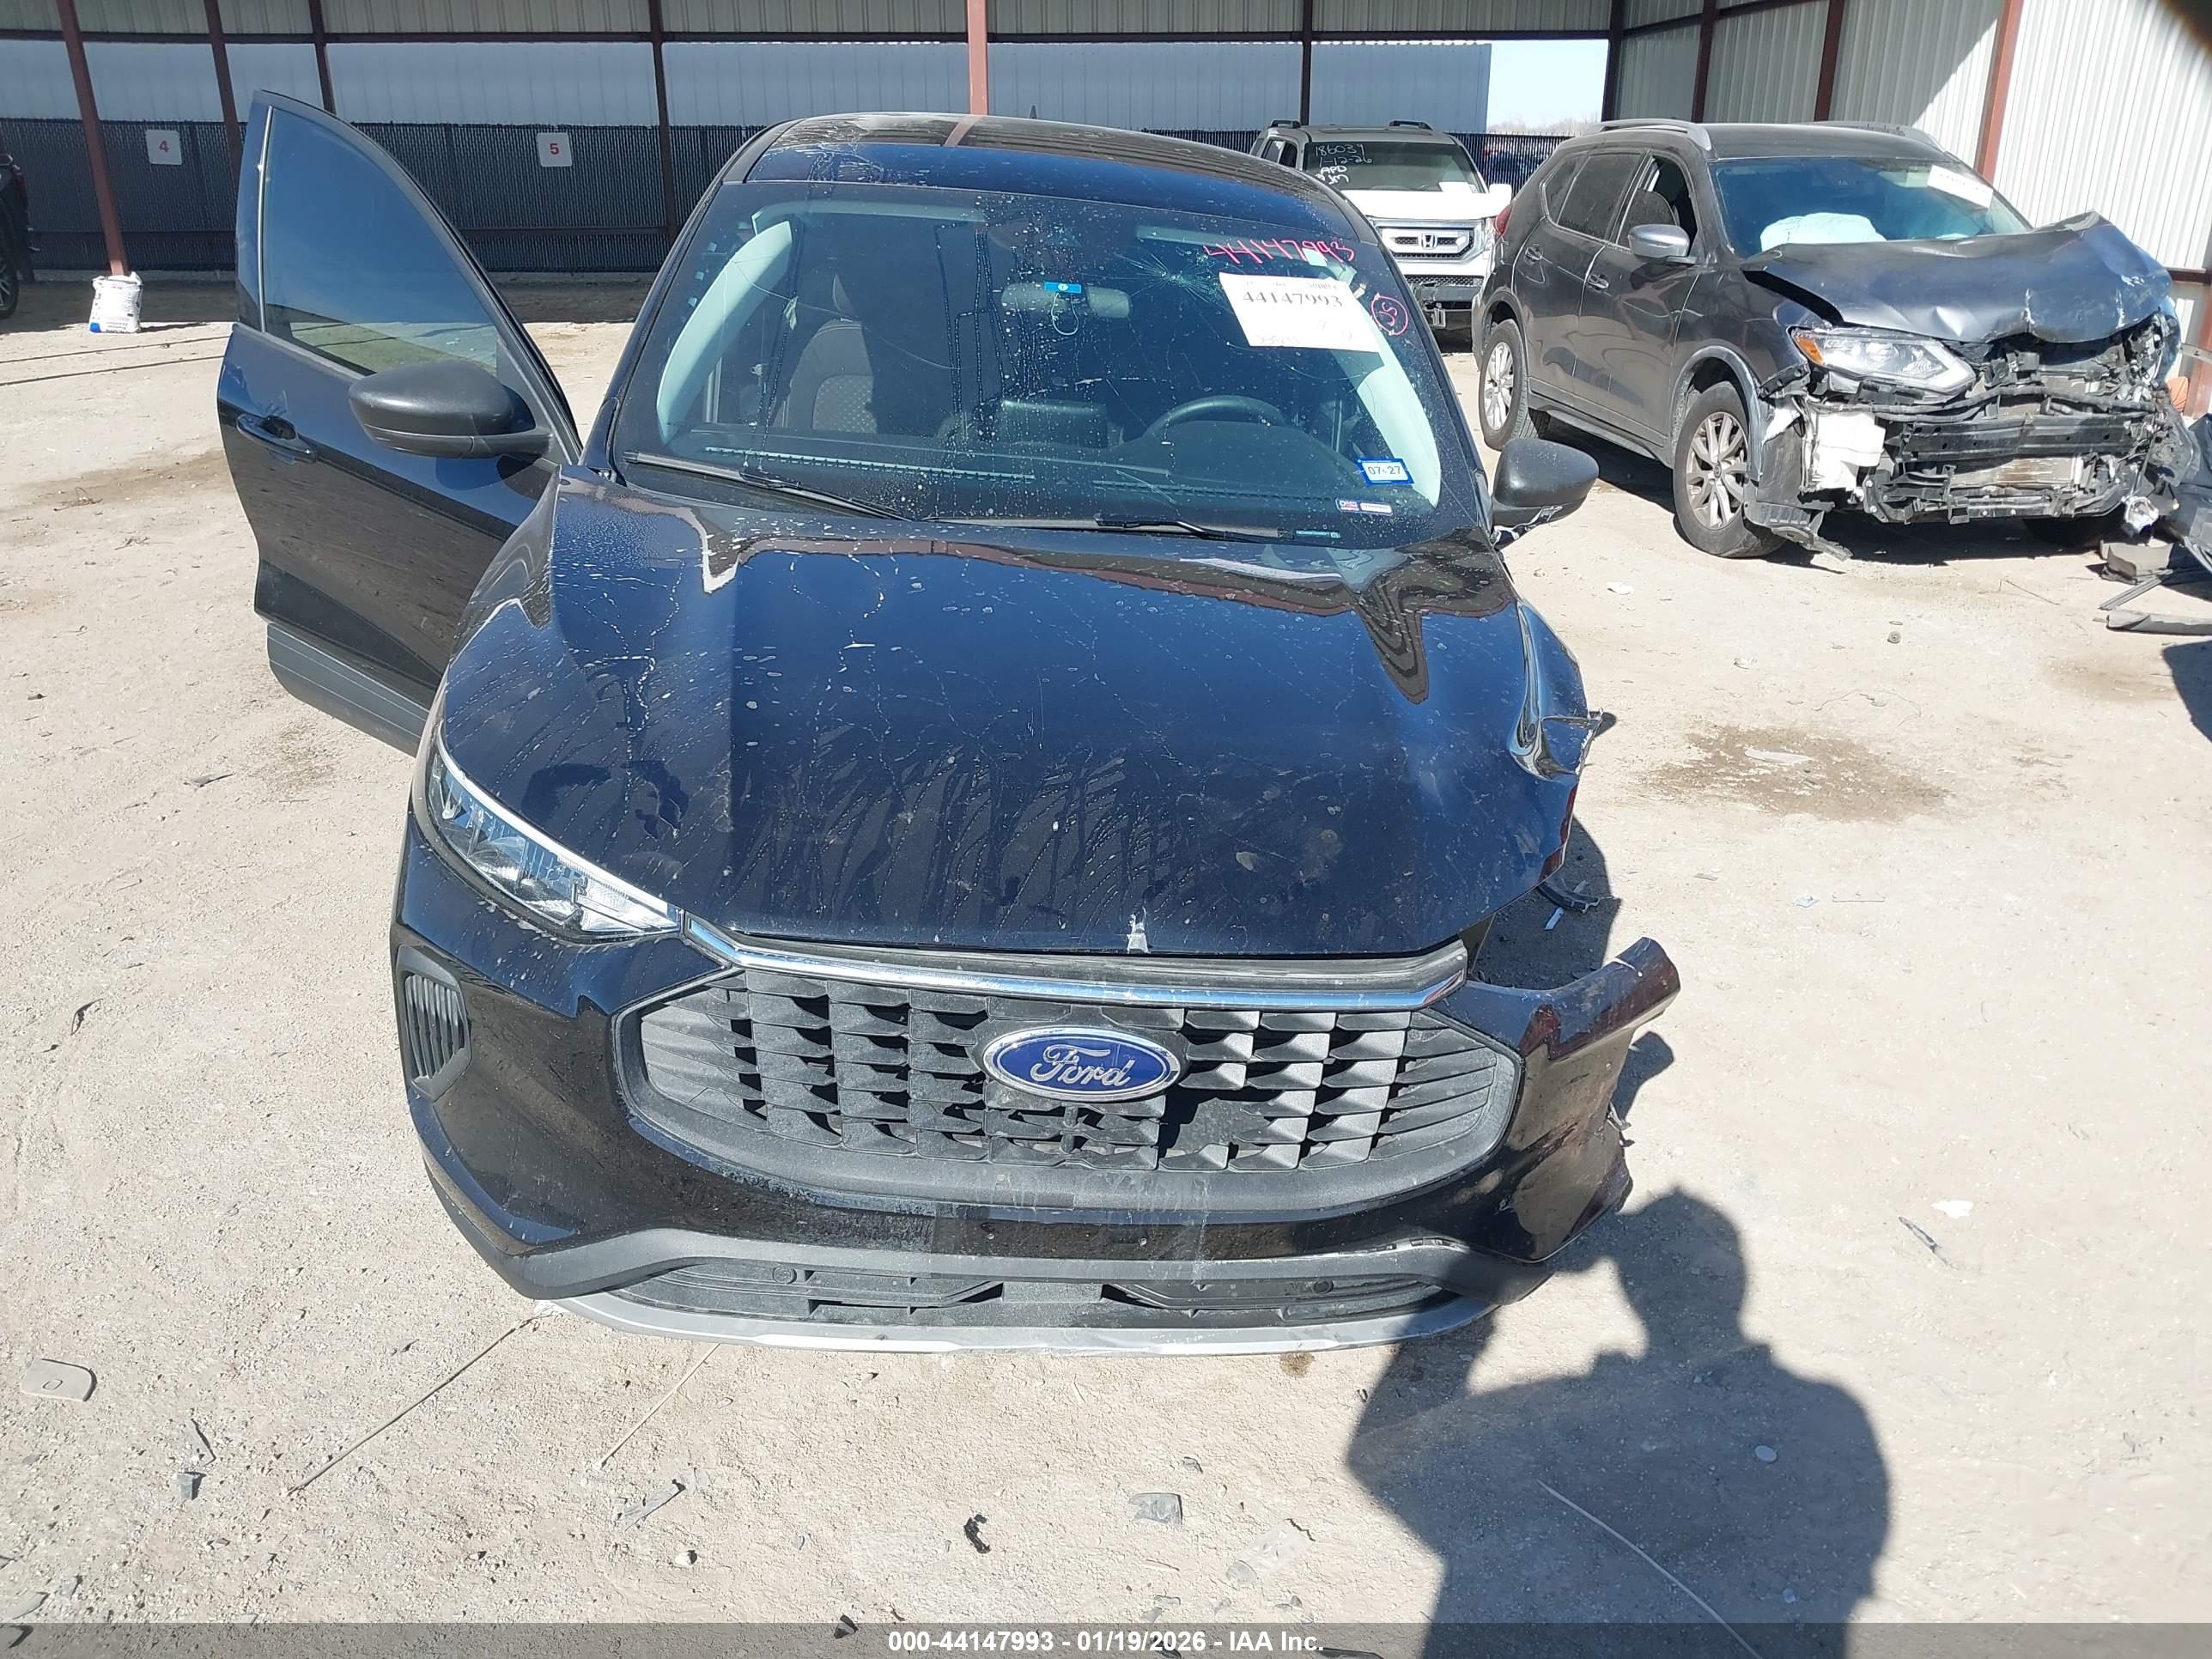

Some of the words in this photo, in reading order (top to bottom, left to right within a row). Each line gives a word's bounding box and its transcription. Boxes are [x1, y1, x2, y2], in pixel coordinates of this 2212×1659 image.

[159, 140, 170, 153] 4
[550, 143, 560, 155] 5
[1204, 239, 1355, 264] 44147993
[1243, 290, 1343, 307] 44147993
[1030, 1043, 1136, 1087] Ford
